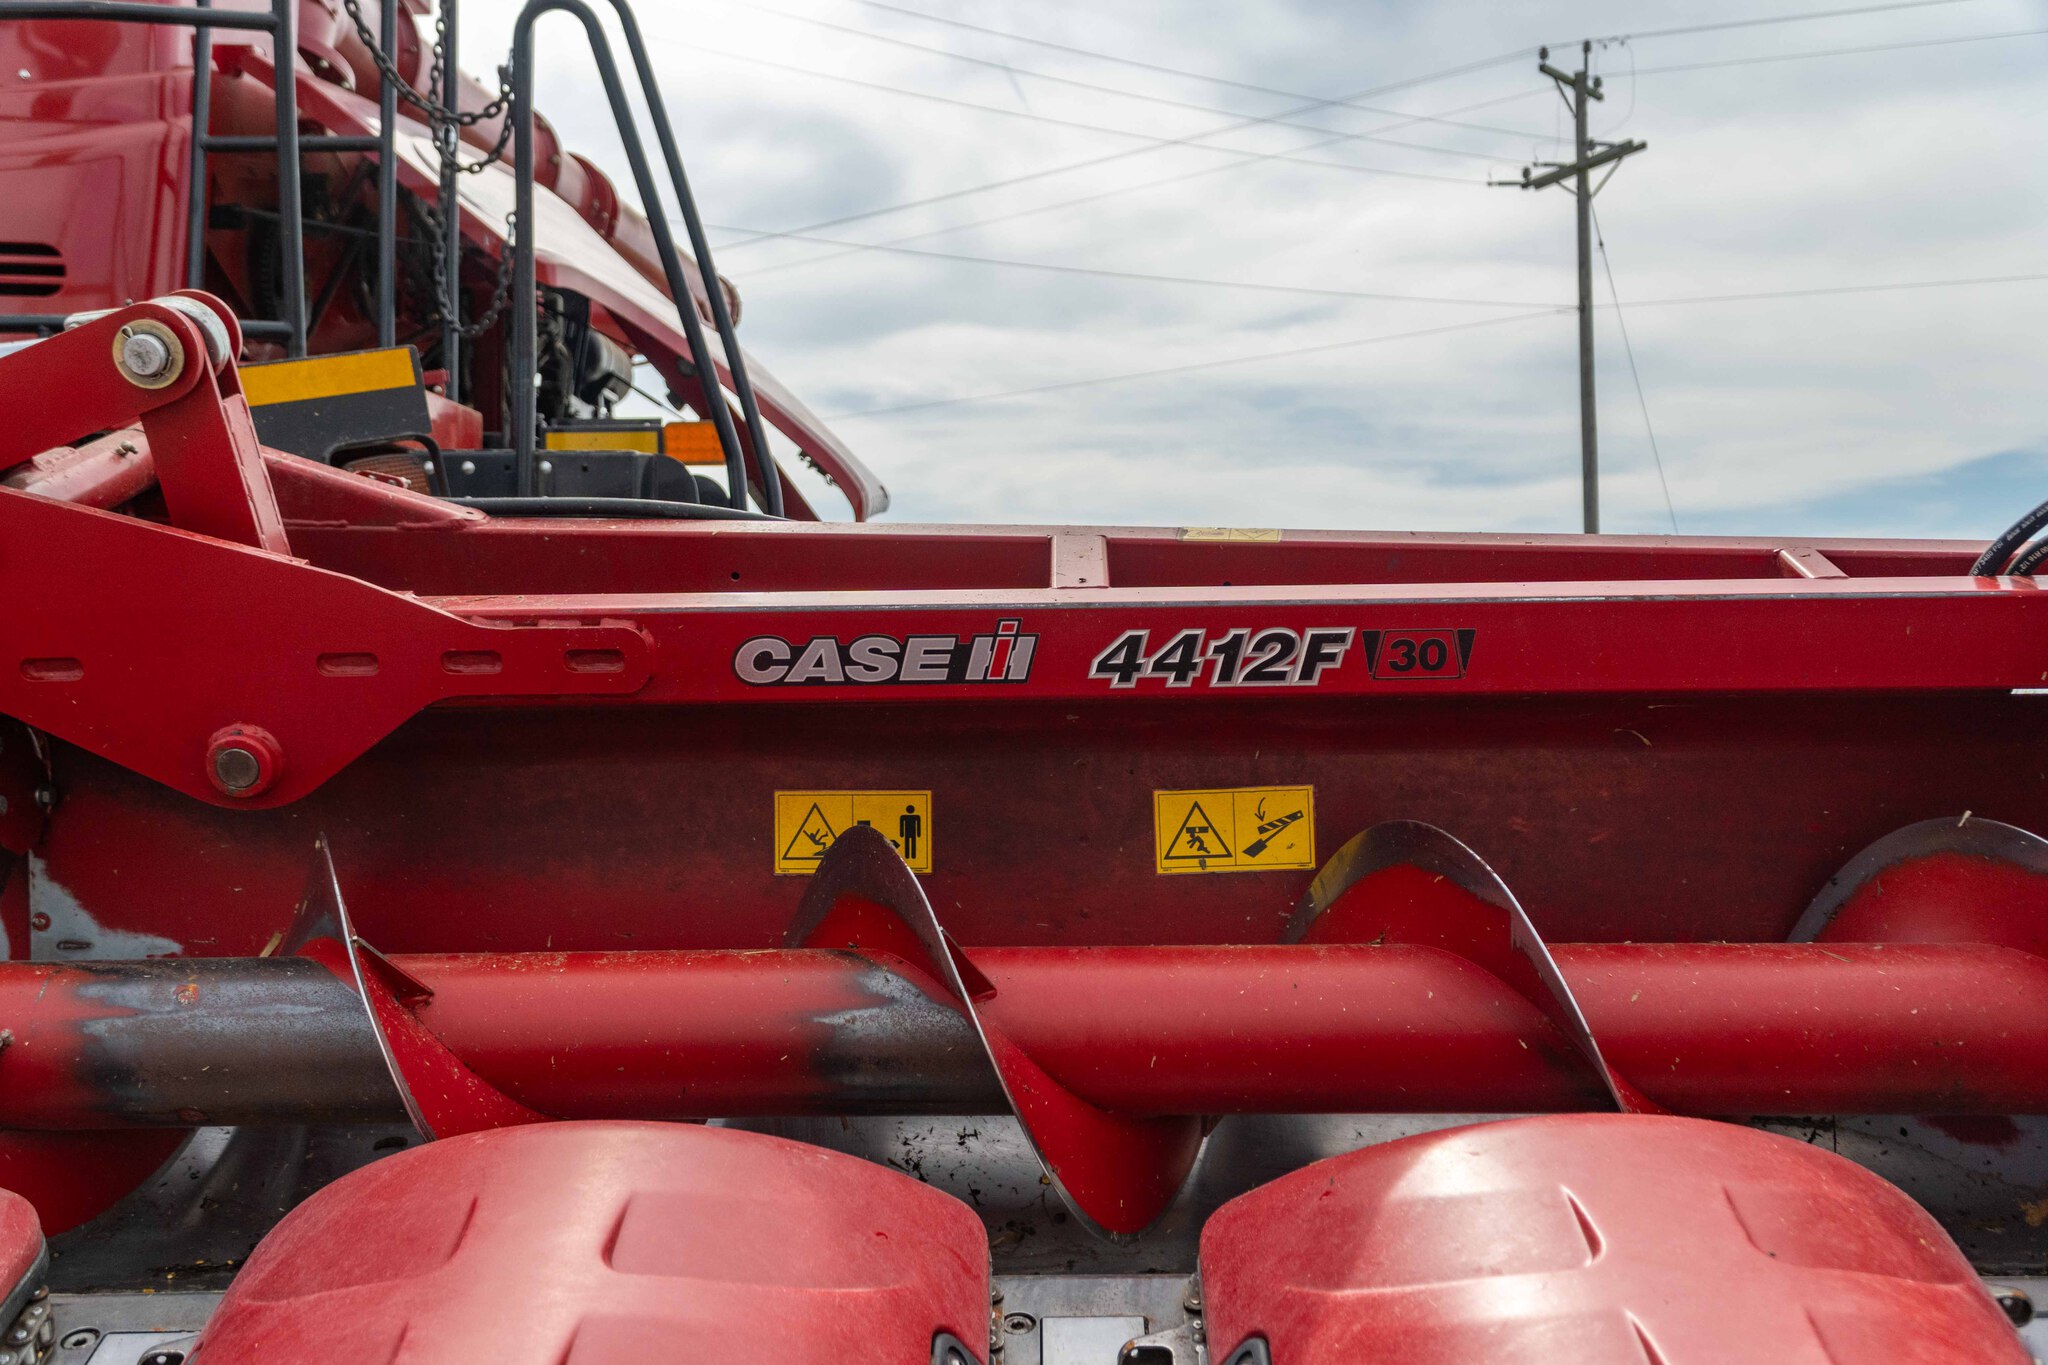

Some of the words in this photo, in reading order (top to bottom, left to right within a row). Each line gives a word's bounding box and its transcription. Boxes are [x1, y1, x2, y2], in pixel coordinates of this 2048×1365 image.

[733, 635, 957, 685] CASE
[1088, 627, 1357, 689] 4412F
[1387, 638, 1450, 673] 30
